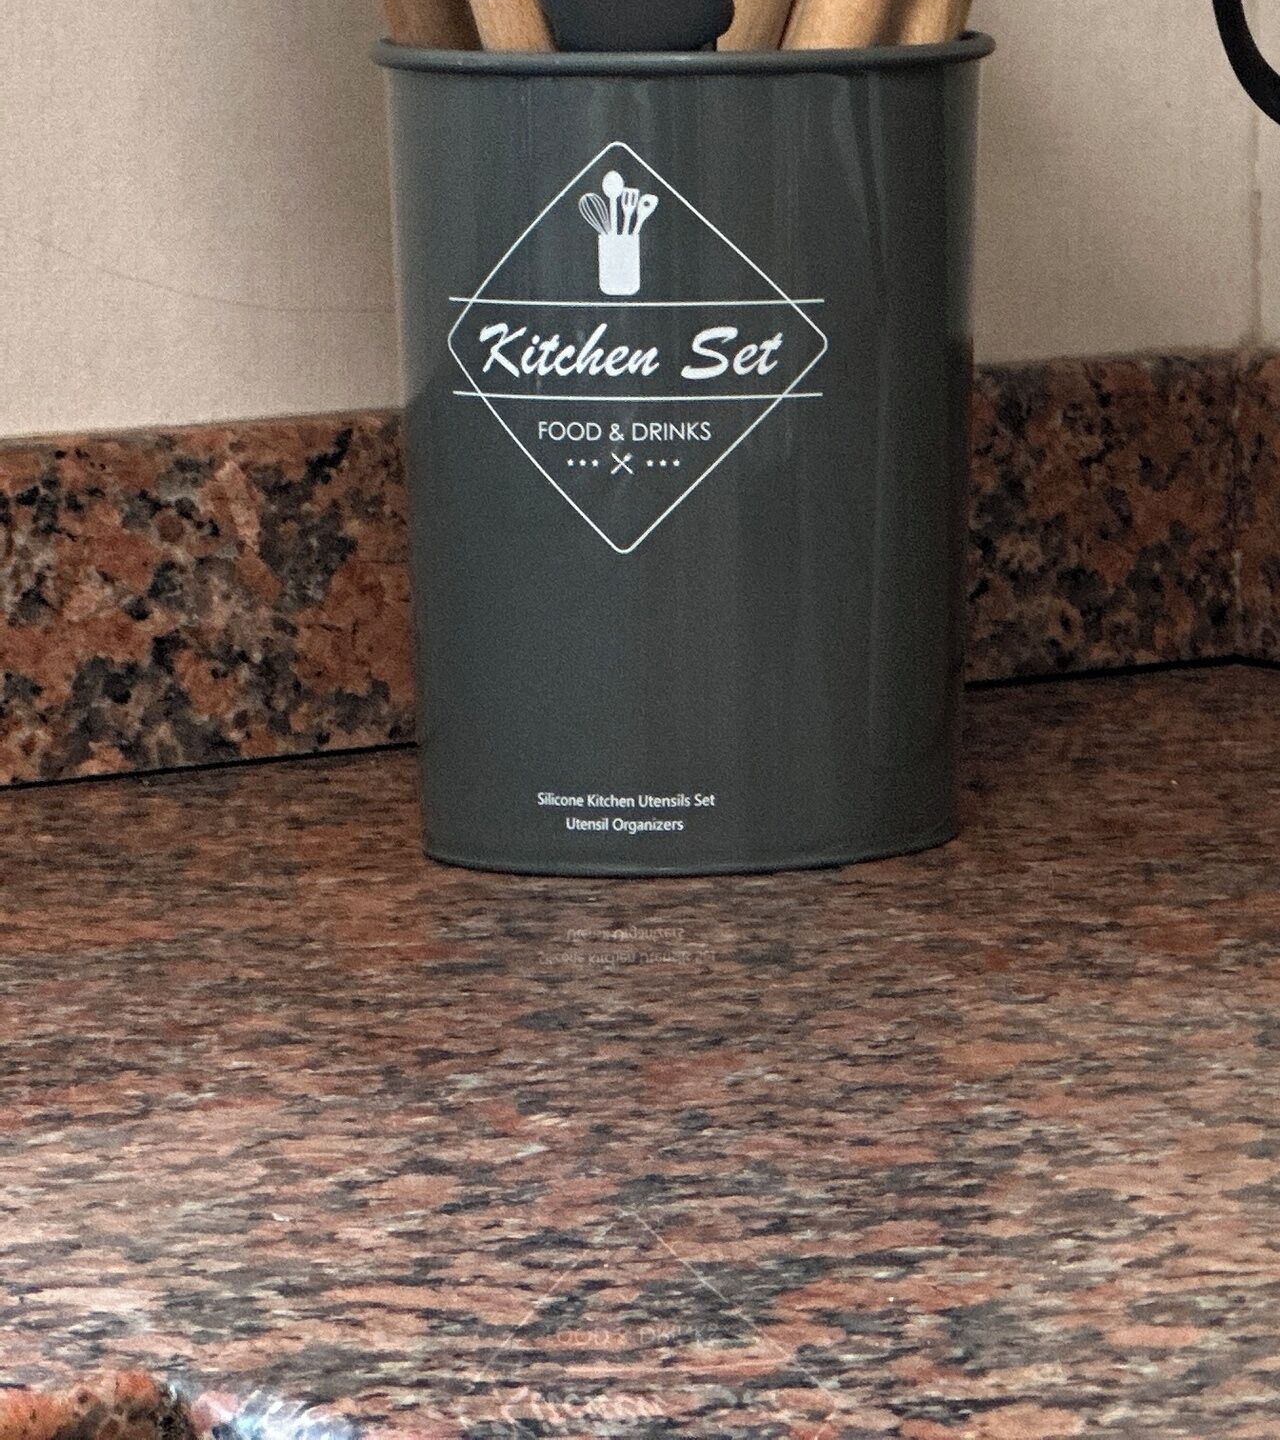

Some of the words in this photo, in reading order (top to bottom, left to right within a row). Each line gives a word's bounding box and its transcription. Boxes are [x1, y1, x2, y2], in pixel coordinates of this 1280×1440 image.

[478, 322, 660, 378] Kitchen
[681, 325, 784, 380] Set
[538, 421, 601, 441] FOOD
[609, 423, 625, 441] &
[631, 421, 712, 441] DRINKS
[537, 791, 584, 807] Silicone
[586, 793, 635, 808] Kitchen
[638, 793, 691, 808] Utensils
[693, 792, 716, 807] Set
[566, 817, 609, 831] Utensil
[612, 817, 684, 835] Organizers
